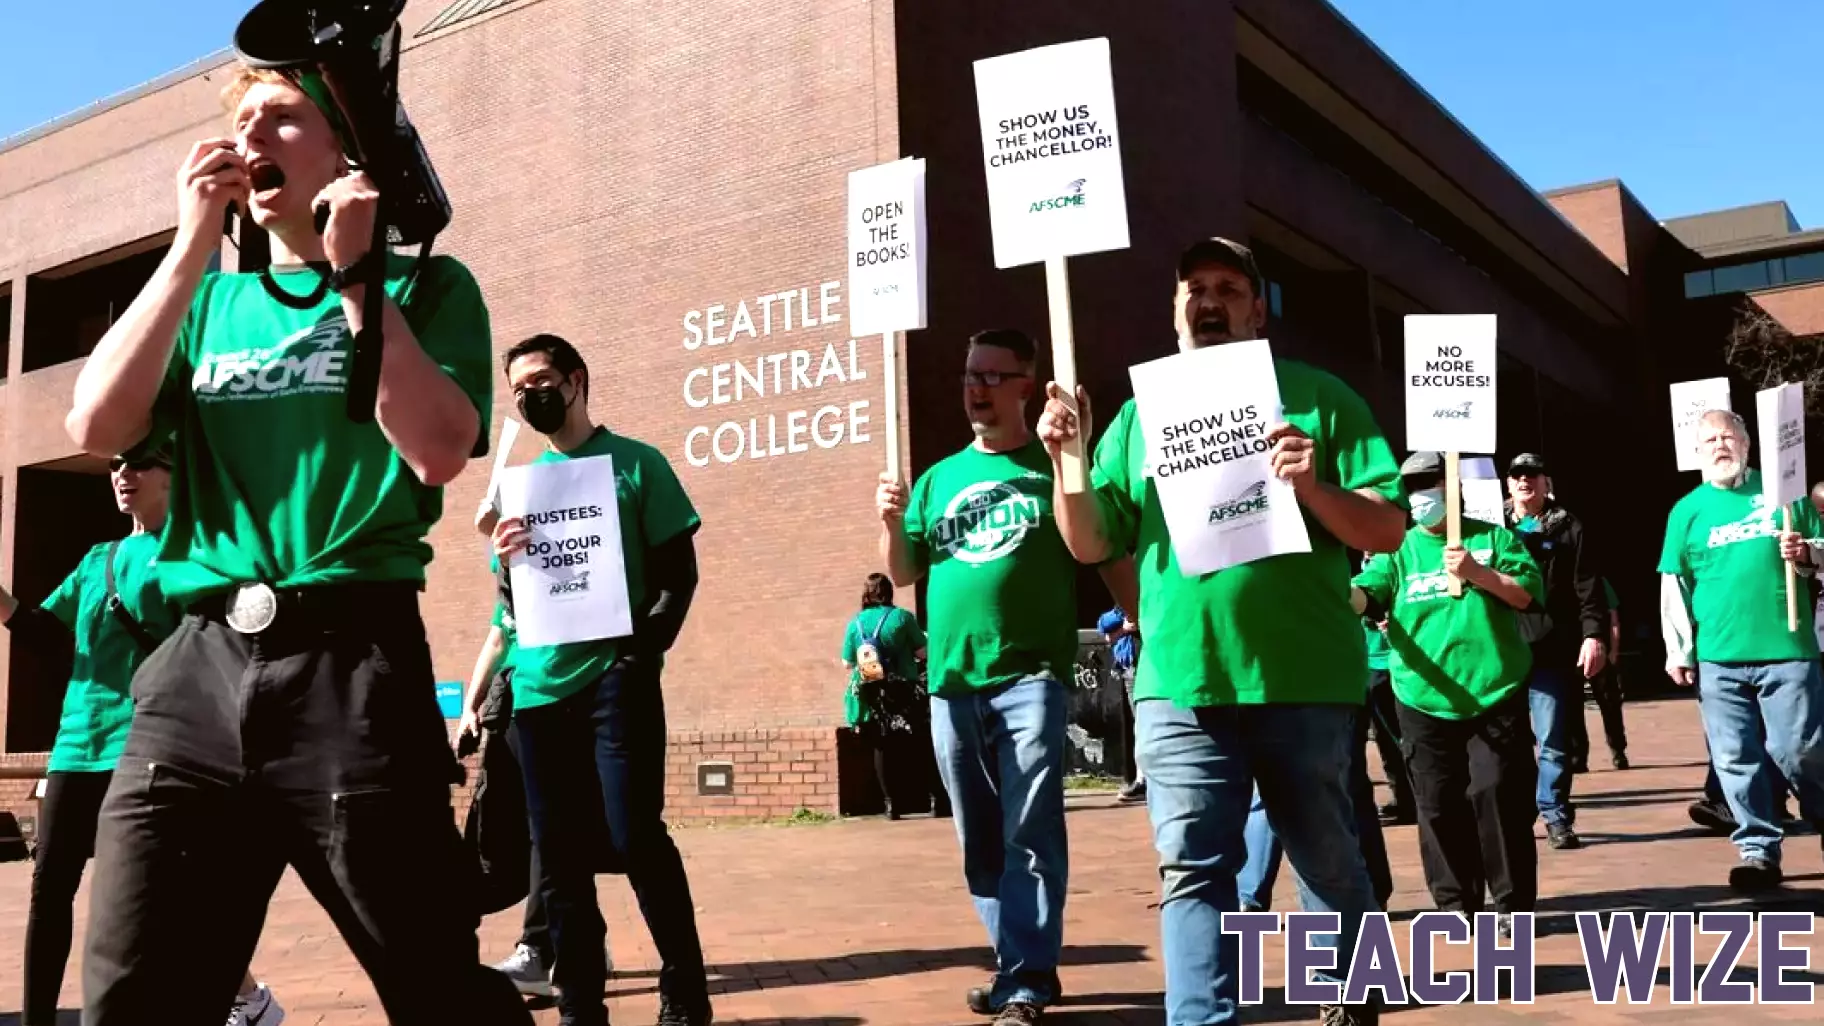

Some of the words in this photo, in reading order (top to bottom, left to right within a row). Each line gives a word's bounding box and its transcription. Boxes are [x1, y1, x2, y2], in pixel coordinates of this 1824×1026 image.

[999, 109, 1057, 134] SHOW
[1063, 104, 1090, 121] US
[995, 133, 1028, 150] THE
[1033, 121, 1103, 143] MONEY,
[990, 135, 1112, 167] CHANCELLOR!
[862, 200, 904, 224] OPEN
[1029, 193, 1085, 213] AFSCME
[869, 223, 899, 244] THE
[856, 241, 910, 267] BOOKS!
[683, 280, 842, 351] SEATTLE
[1437, 345, 1463, 358] NO
[191, 350, 347, 394] AFSCME
[683, 339, 867, 408] CENTRAL
[1425, 360, 1475, 373] MORE
[1411, 375, 1491, 388] EXCUSES!
[684, 399, 871, 467] COLLEGE
[1162, 412, 1223, 441] SHOW
[1230, 404, 1258, 422] US
[1160, 439, 1196, 459] THE
[525, 505, 603, 526] RUSTEES:
[1208, 495, 1268, 522] AFSCME
[935, 496, 1040, 552] UNION
[526, 541, 551, 556] DO
[555, 534, 602, 552] YOUR
[541, 551, 589, 569] JOBS!
